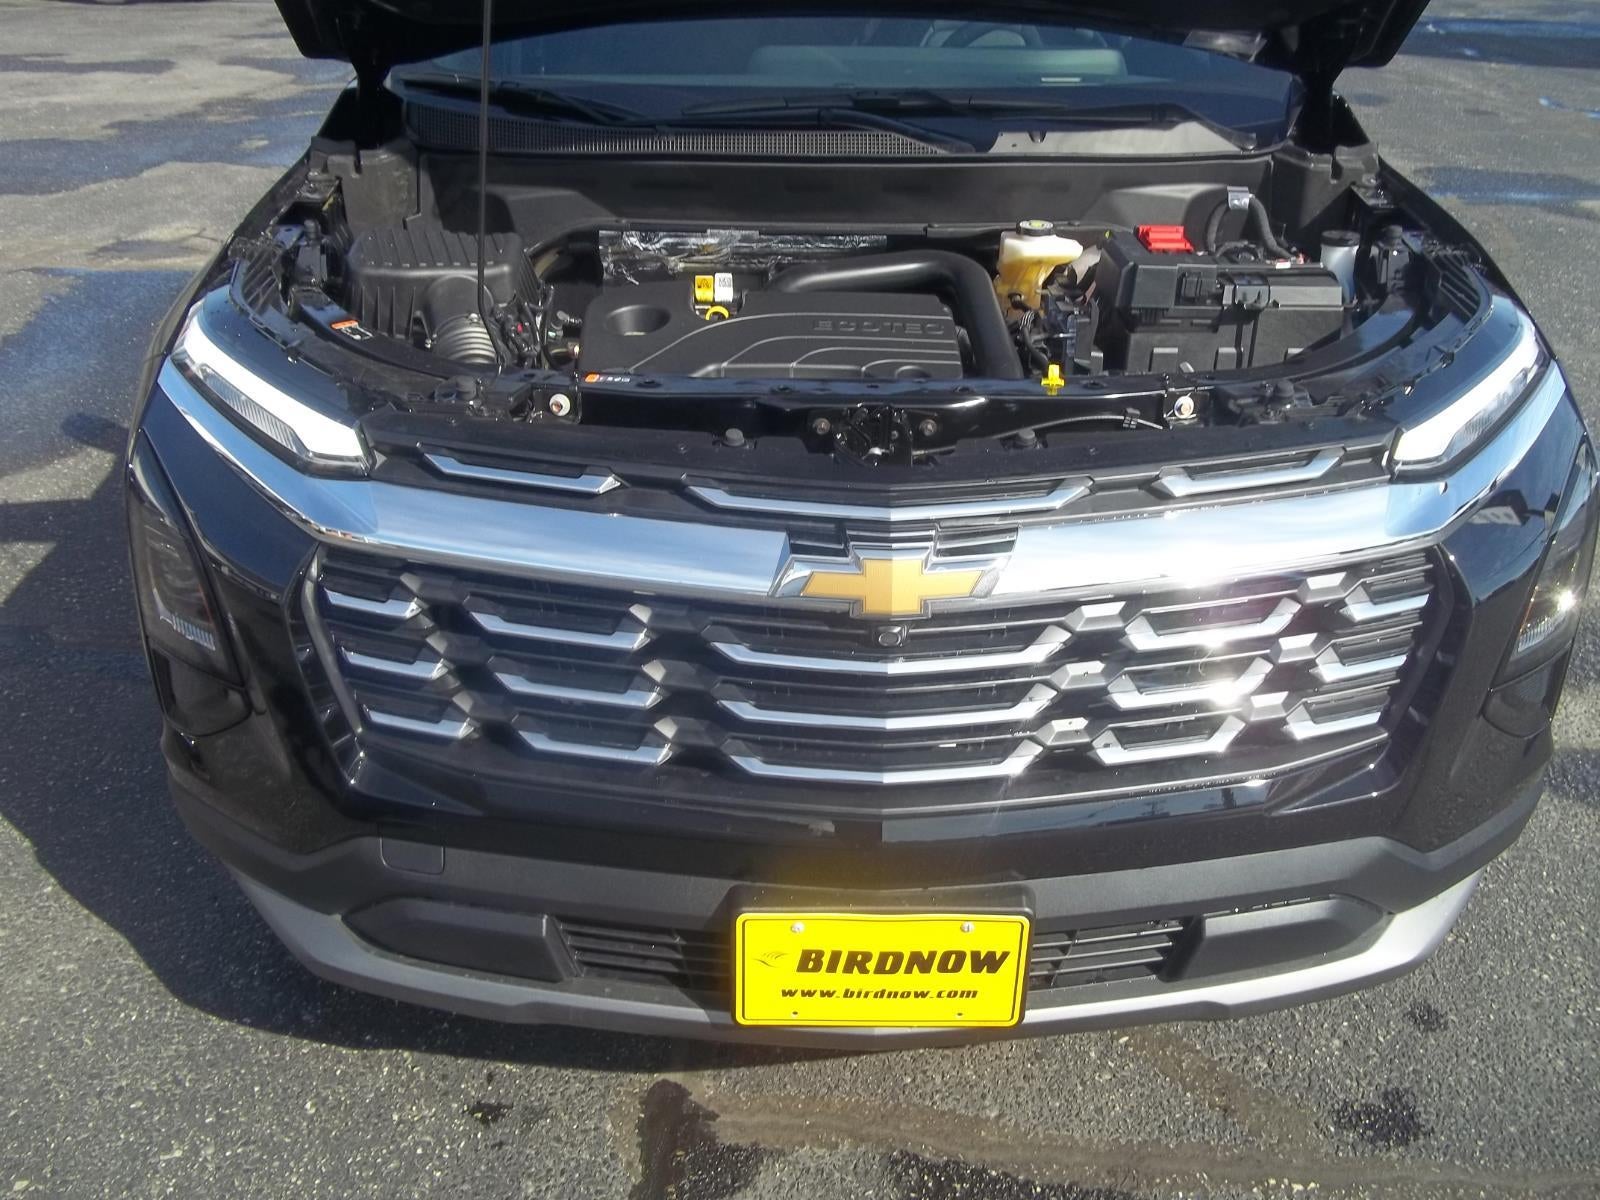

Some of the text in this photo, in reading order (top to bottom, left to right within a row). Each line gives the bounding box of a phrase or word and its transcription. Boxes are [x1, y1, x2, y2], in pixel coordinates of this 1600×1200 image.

[813, 320, 945, 335] ECOTEC
[796, 949, 1011, 975] BIRDNOW
[781, 988, 979, 999] www.birdnow.com
